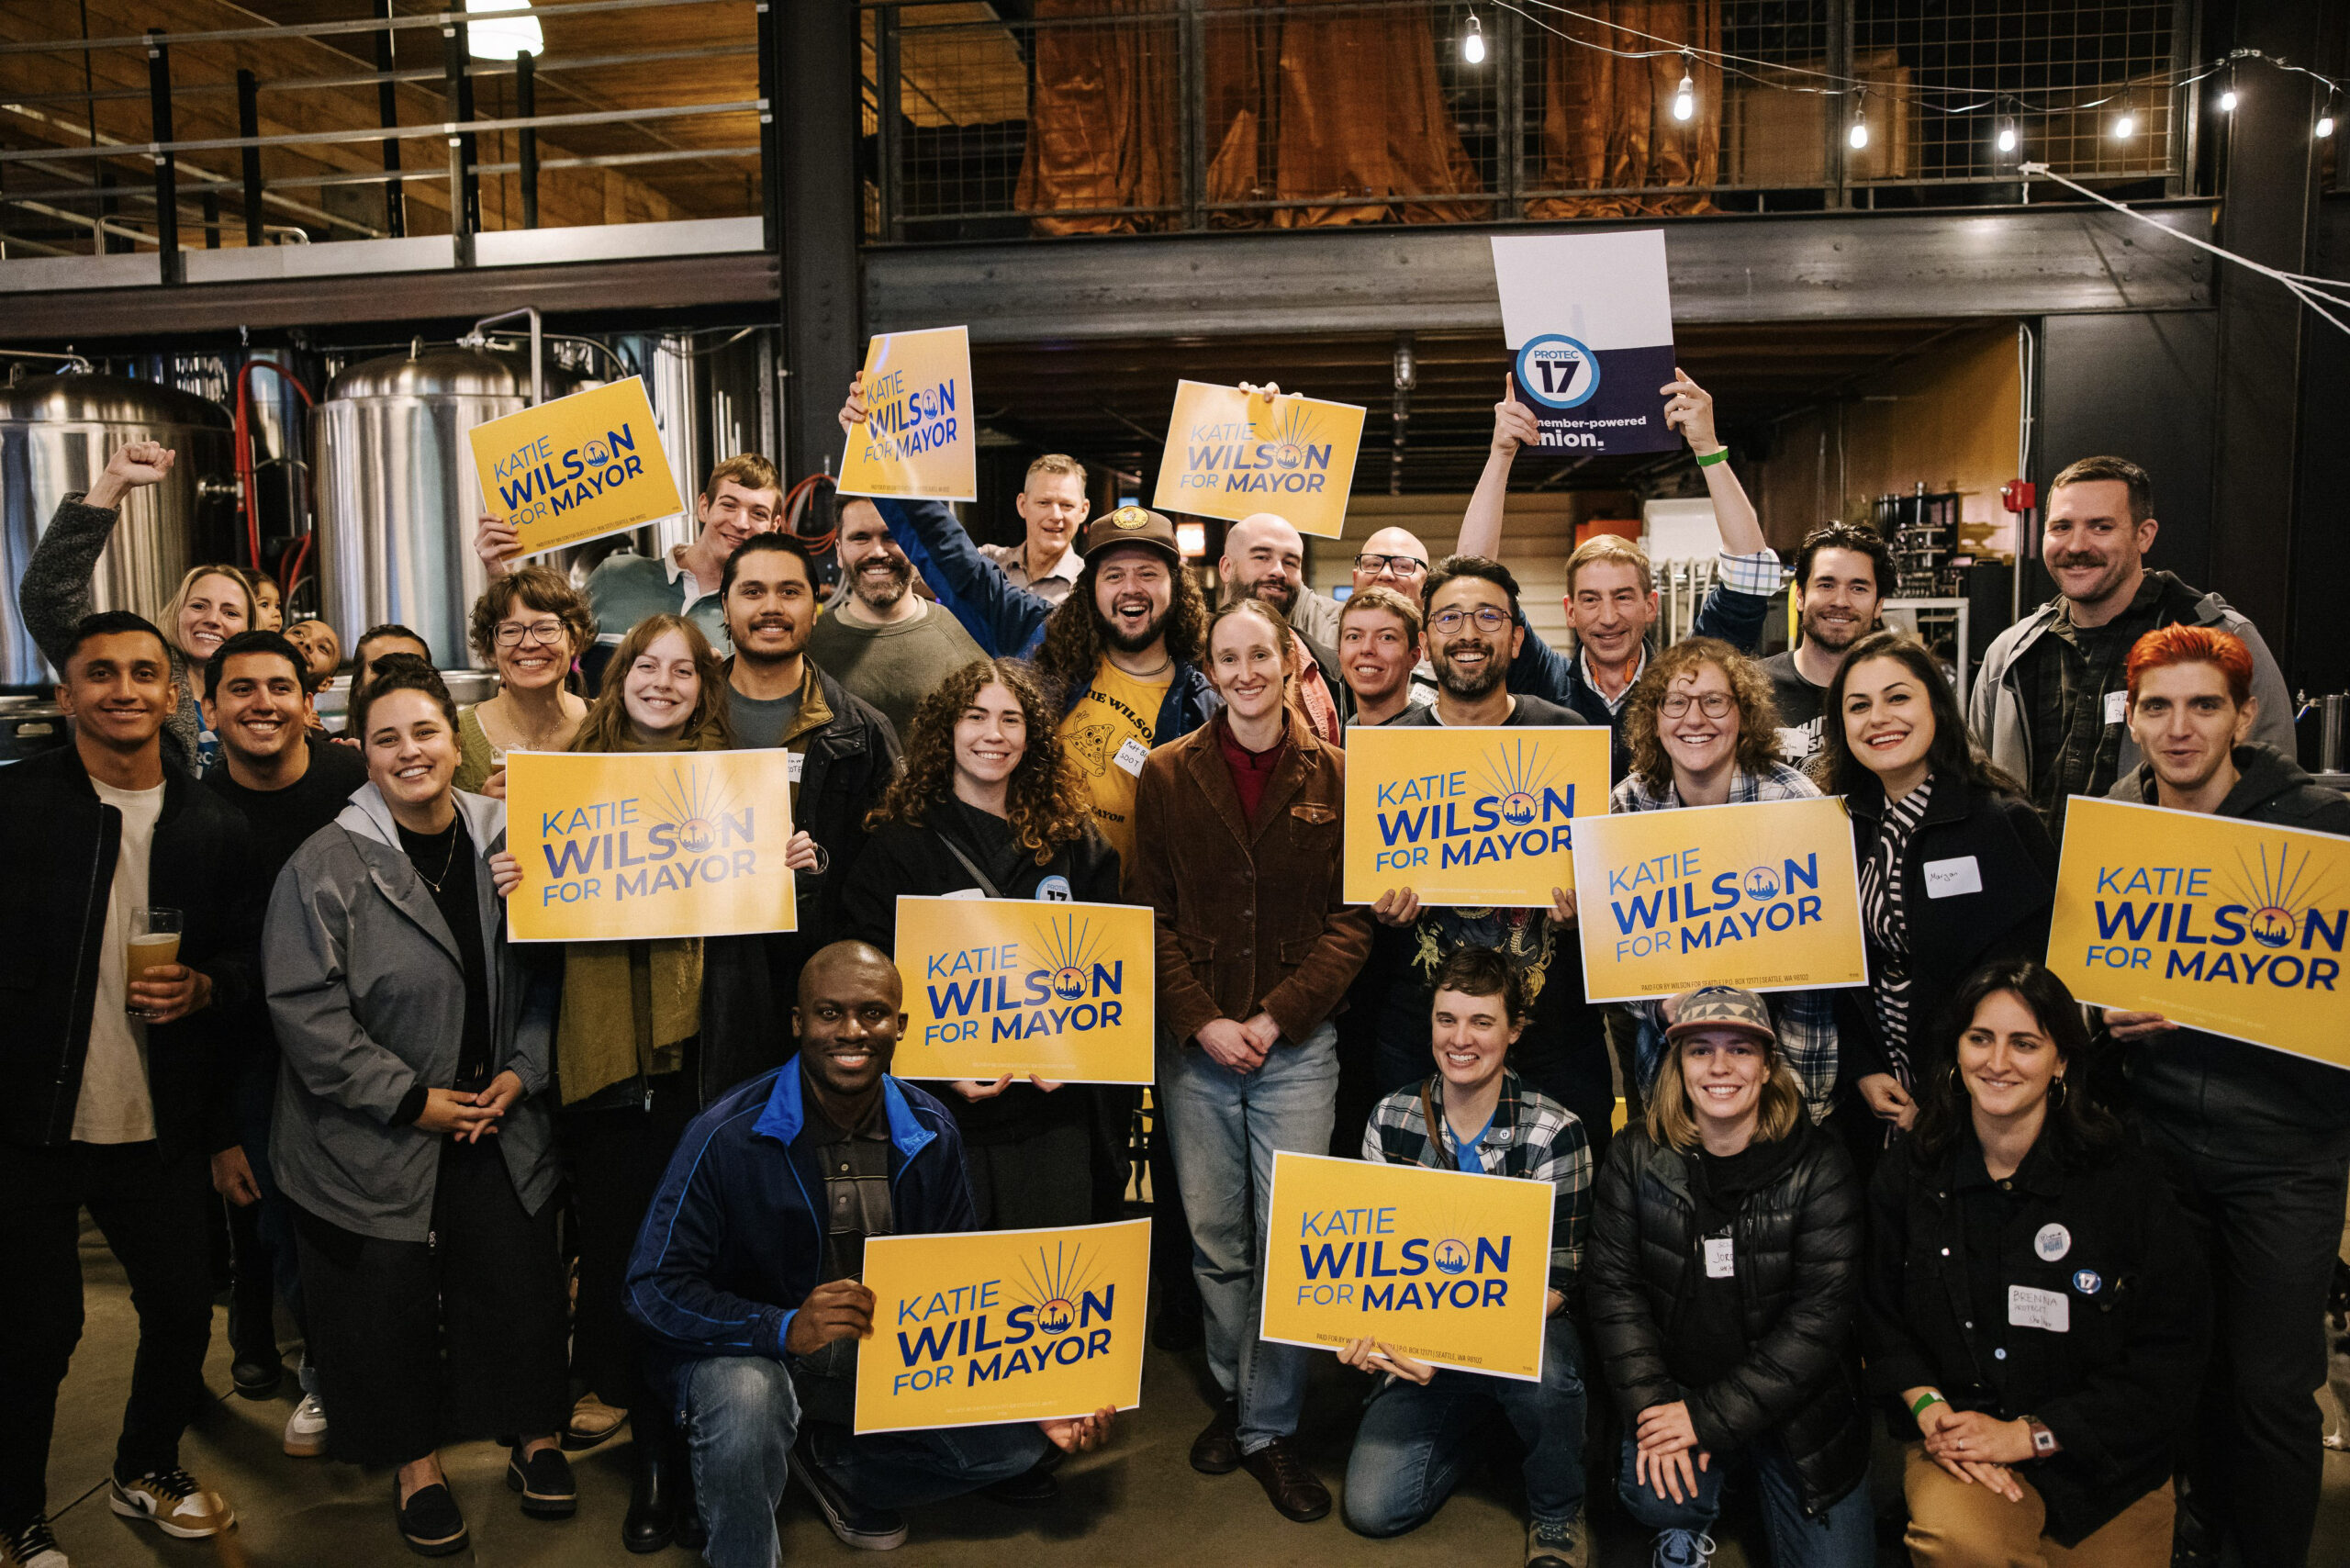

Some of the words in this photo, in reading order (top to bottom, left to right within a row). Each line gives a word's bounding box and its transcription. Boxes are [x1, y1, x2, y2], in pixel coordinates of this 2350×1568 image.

[1534, 351, 1579, 359] PROTEC
[1536, 361, 1580, 393] 17
[867, 370, 904, 407] KATIE
[868, 379, 956, 441] WILSON
[863, 441, 892, 463] FOR
[896, 418, 957, 462] MAYOR
[1191, 423, 1257, 441] KATIE
[1537, 430, 1605, 447] nion.
[494, 435, 553, 483] KATIE
[499, 423, 635, 510] WILSON
[1188, 444, 1332, 471] WILSON
[509, 501, 548, 526] FOR
[550, 454, 644, 517] MAYOR
[1181, 474, 1219, 488] FOR
[1225, 473, 1326, 493] MAYOR
[1109, 696, 1154, 745] WILSO
[1377, 770, 1467, 808] KATIE
[543, 798, 640, 838] KATIE
[1377, 783, 1575, 846] WILSON
[543, 807, 755, 879] WILSON
[1376, 846, 1429, 872] FOR
[1441, 824, 1572, 869] MAYOR
[543, 878, 601, 907] FOR
[615, 849, 756, 902] MAYOR
[1608, 847, 1702, 896] KATIE
[1610, 852, 1818, 935] WILSON
[2097, 867, 2211, 897] KATIE
[1617, 930, 1672, 962] FOR
[1681, 895, 1822, 955] MAYOR
[2094, 901, 2349, 953] WILSON
[927, 944, 1019, 980] KATIE
[2086, 946, 2152, 969] FOR
[2165, 949, 2340, 991] MAYOR
[927, 960, 1123, 1020] WILSON
[924, 1020, 979, 1047] FOR
[991, 1001, 1123, 1044] MAYOR
[1301, 1207, 1396, 1238] KATIE
[1300, 1235, 1512, 1280] WILSON
[898, 1279, 1002, 1326] KATIE
[1297, 1283, 1354, 1305] FOR
[1361, 1279, 1508, 1312] MAYOR
[2013, 1290, 2057, 1306] BRENNA
[2078, 1272, 2097, 1289] 17
[897, 1283, 1115, 1367] WILSON
[892, 1365, 955, 1395] FOR
[968, 1328, 1112, 1387] MAYOR
